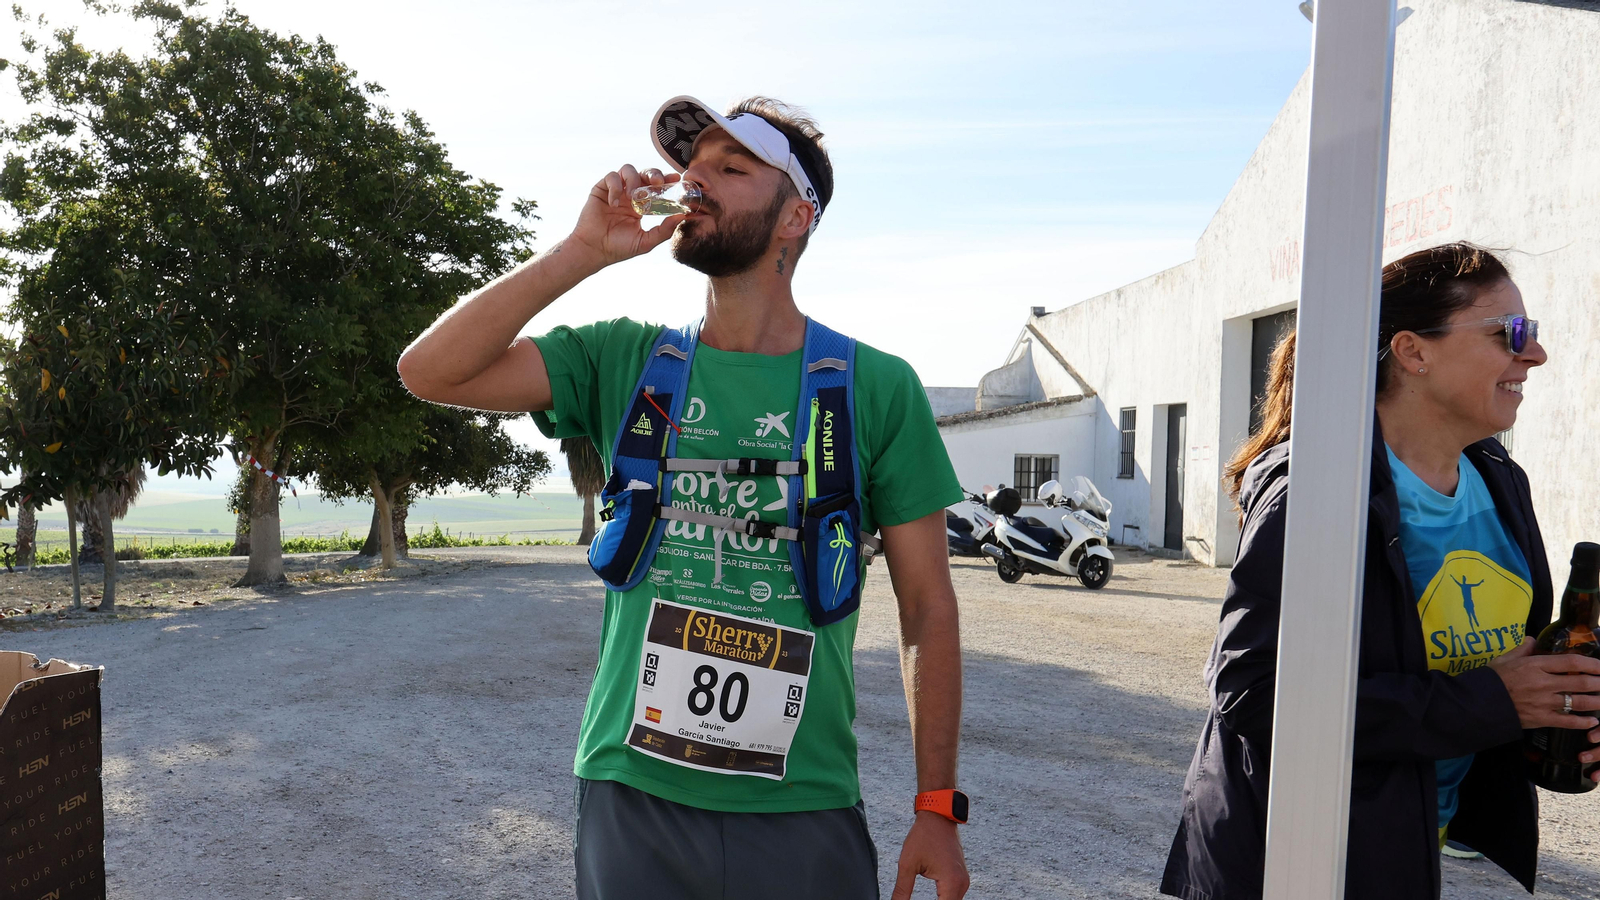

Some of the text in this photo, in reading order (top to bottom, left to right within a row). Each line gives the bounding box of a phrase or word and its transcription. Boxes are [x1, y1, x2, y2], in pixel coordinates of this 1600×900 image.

[693, 427, 719, 437] BELCÓN
[738, 439, 756, 448] Obra
[756, 441, 777, 450] Social
[823, 410, 834, 472] AONIJIE
[671, 472, 759, 509] orre
[672, 496, 716, 516] ontra
[693, 553, 738, 567] SANLCAR
[738, 560, 751, 569] DE
[751, 562, 773, 571] BDA.
[777, 564, 794, 573] 7.5K
[676, 594, 697, 603] VERDE
[692, 616, 775, 661] Sherry
[703, 639, 757, 662] Maratón
[1430, 623, 1526, 661] Sherry
[1445, 654, 1506, 674] Marat
[10, 682, 96, 724] FUEL YOUR
[687, 665, 750, 724] 80
[16, 708, 92, 748] RIDE HSN
[677, 727, 704, 744] García
[705, 733, 741, 750] Santiago
[698, 720, 727, 735] Javier
[18, 736, 95, 779] HSN FUEL
[4, 765, 89, 810] YOUR RIDE
[10, 791, 88, 837] RIDE HSN
[6, 816, 93, 866] FUEL YOUR
[8, 843, 95, 893] YOUR RIDE
[69, 869, 97, 891] FUE
